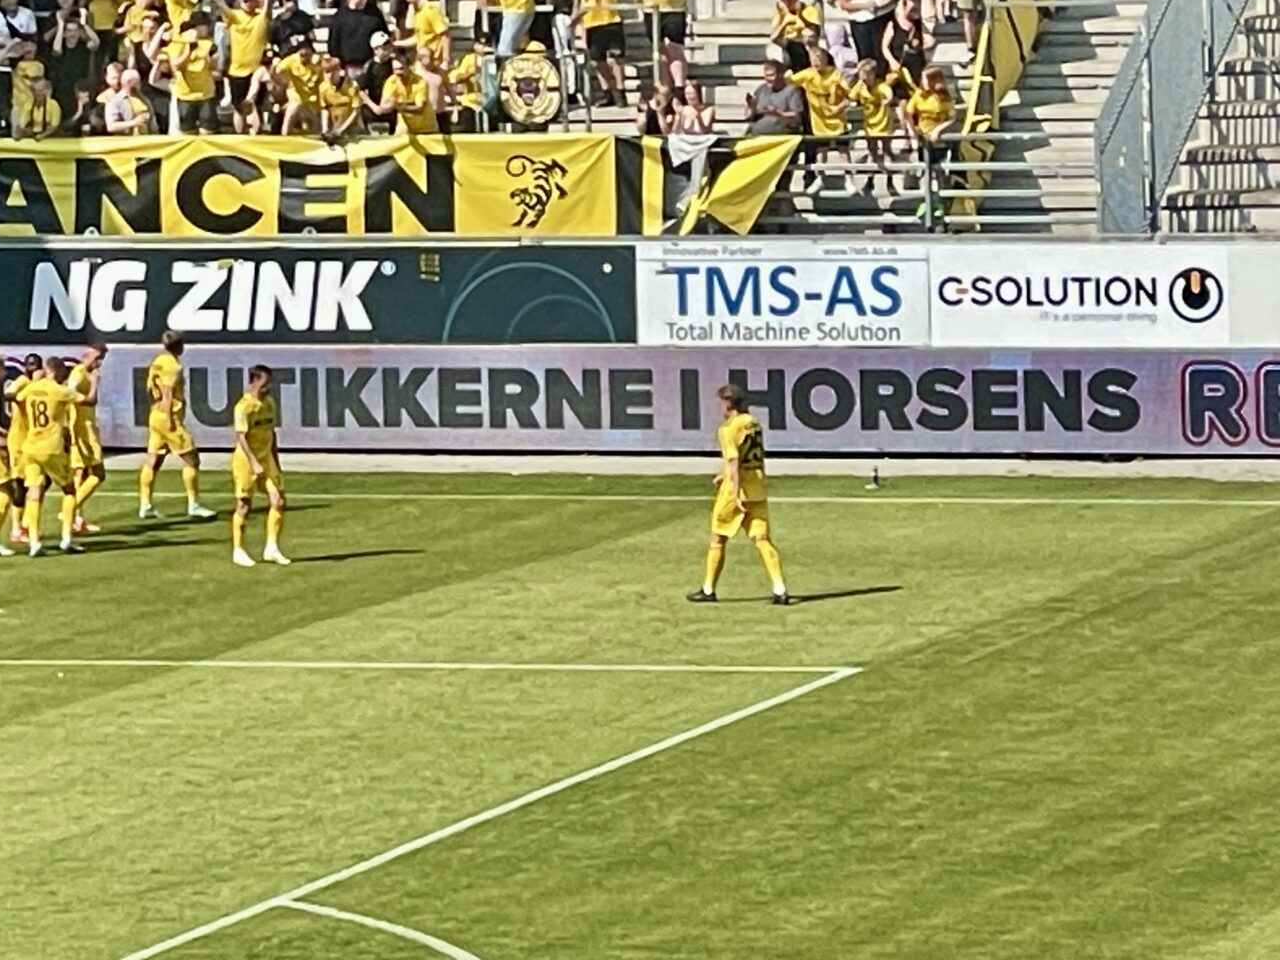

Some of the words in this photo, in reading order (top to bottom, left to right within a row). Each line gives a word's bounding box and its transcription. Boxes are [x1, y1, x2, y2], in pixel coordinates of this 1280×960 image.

[29, 259, 148, 332] NG
[666, 265, 903, 317] TMS-AS
[666, 322, 713, 341] Total
[720, 322, 810, 341] Machine
[816, 322, 901, 341] Solution
[31, 400, 50, 428] 18
[680, 368, 702, 431] I
[728, 367, 1141, 433] HORSENS
